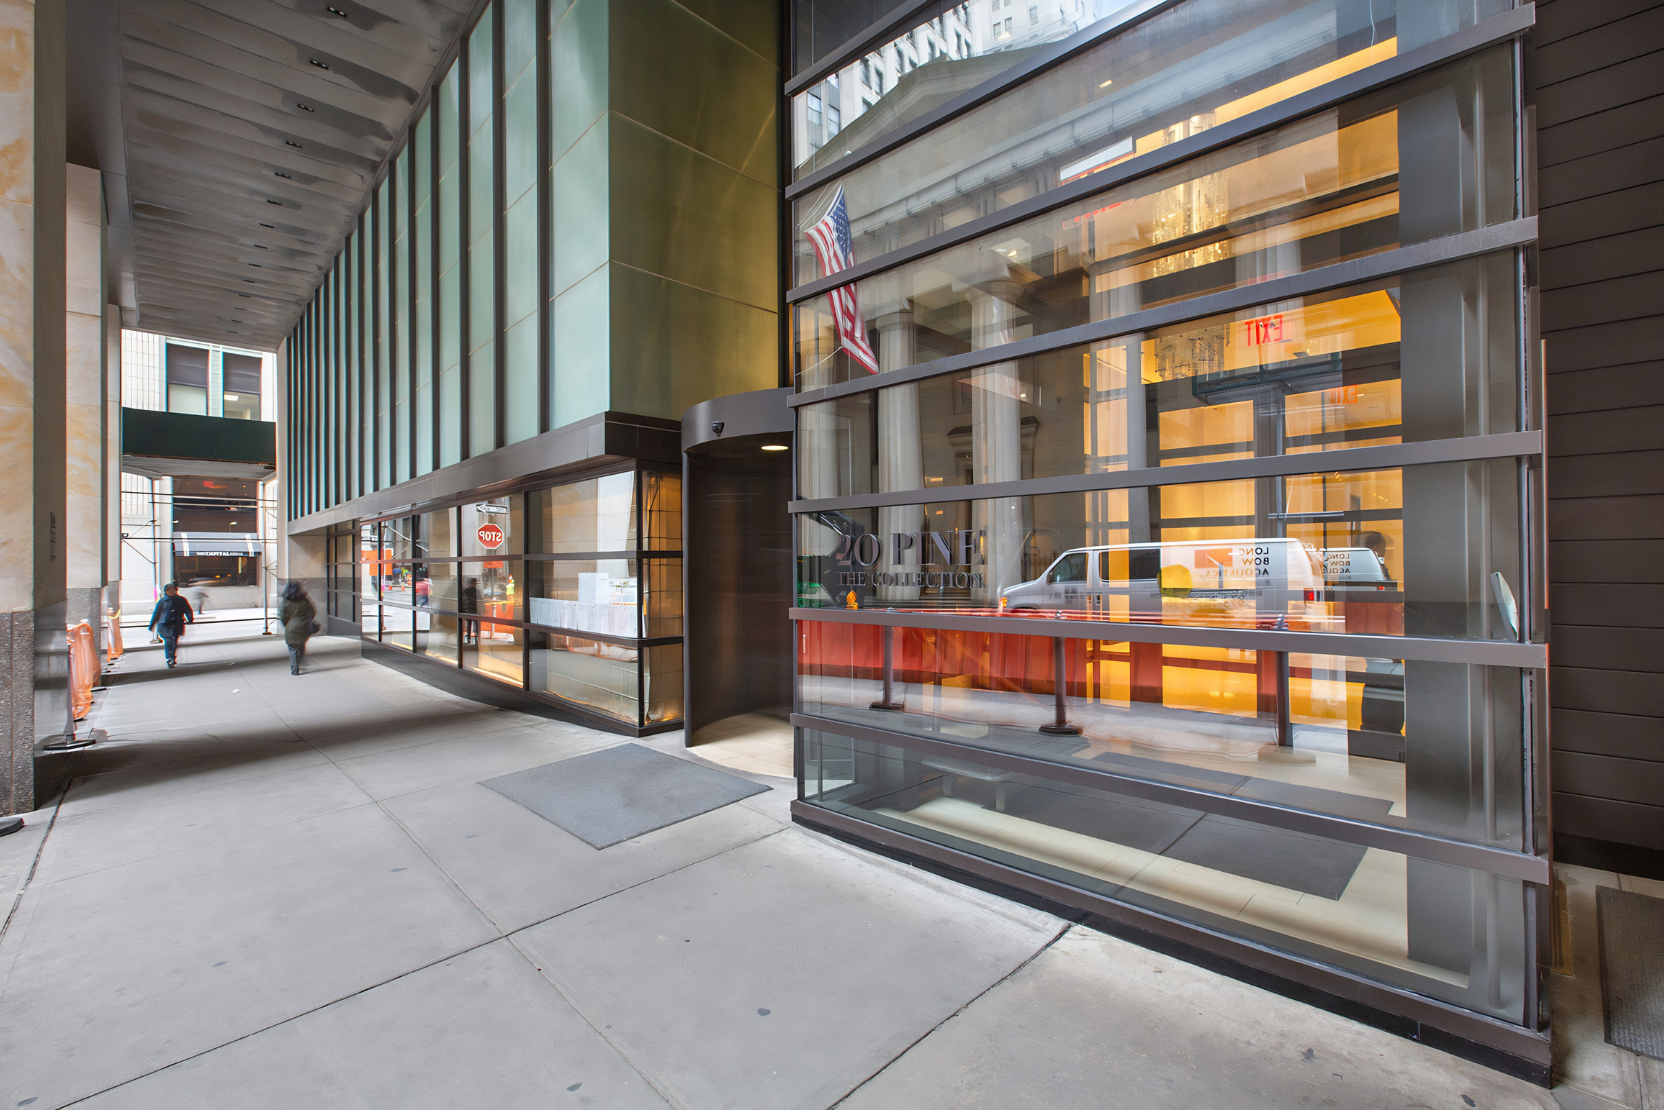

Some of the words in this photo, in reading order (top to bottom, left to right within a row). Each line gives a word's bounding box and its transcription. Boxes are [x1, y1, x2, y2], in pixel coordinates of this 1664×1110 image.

[835, 533, 882, 567] 20
[890, 529, 985, 566] PINE
[837, 572, 866, 586] THE
[872, 571, 985, 588] COLLECTION
